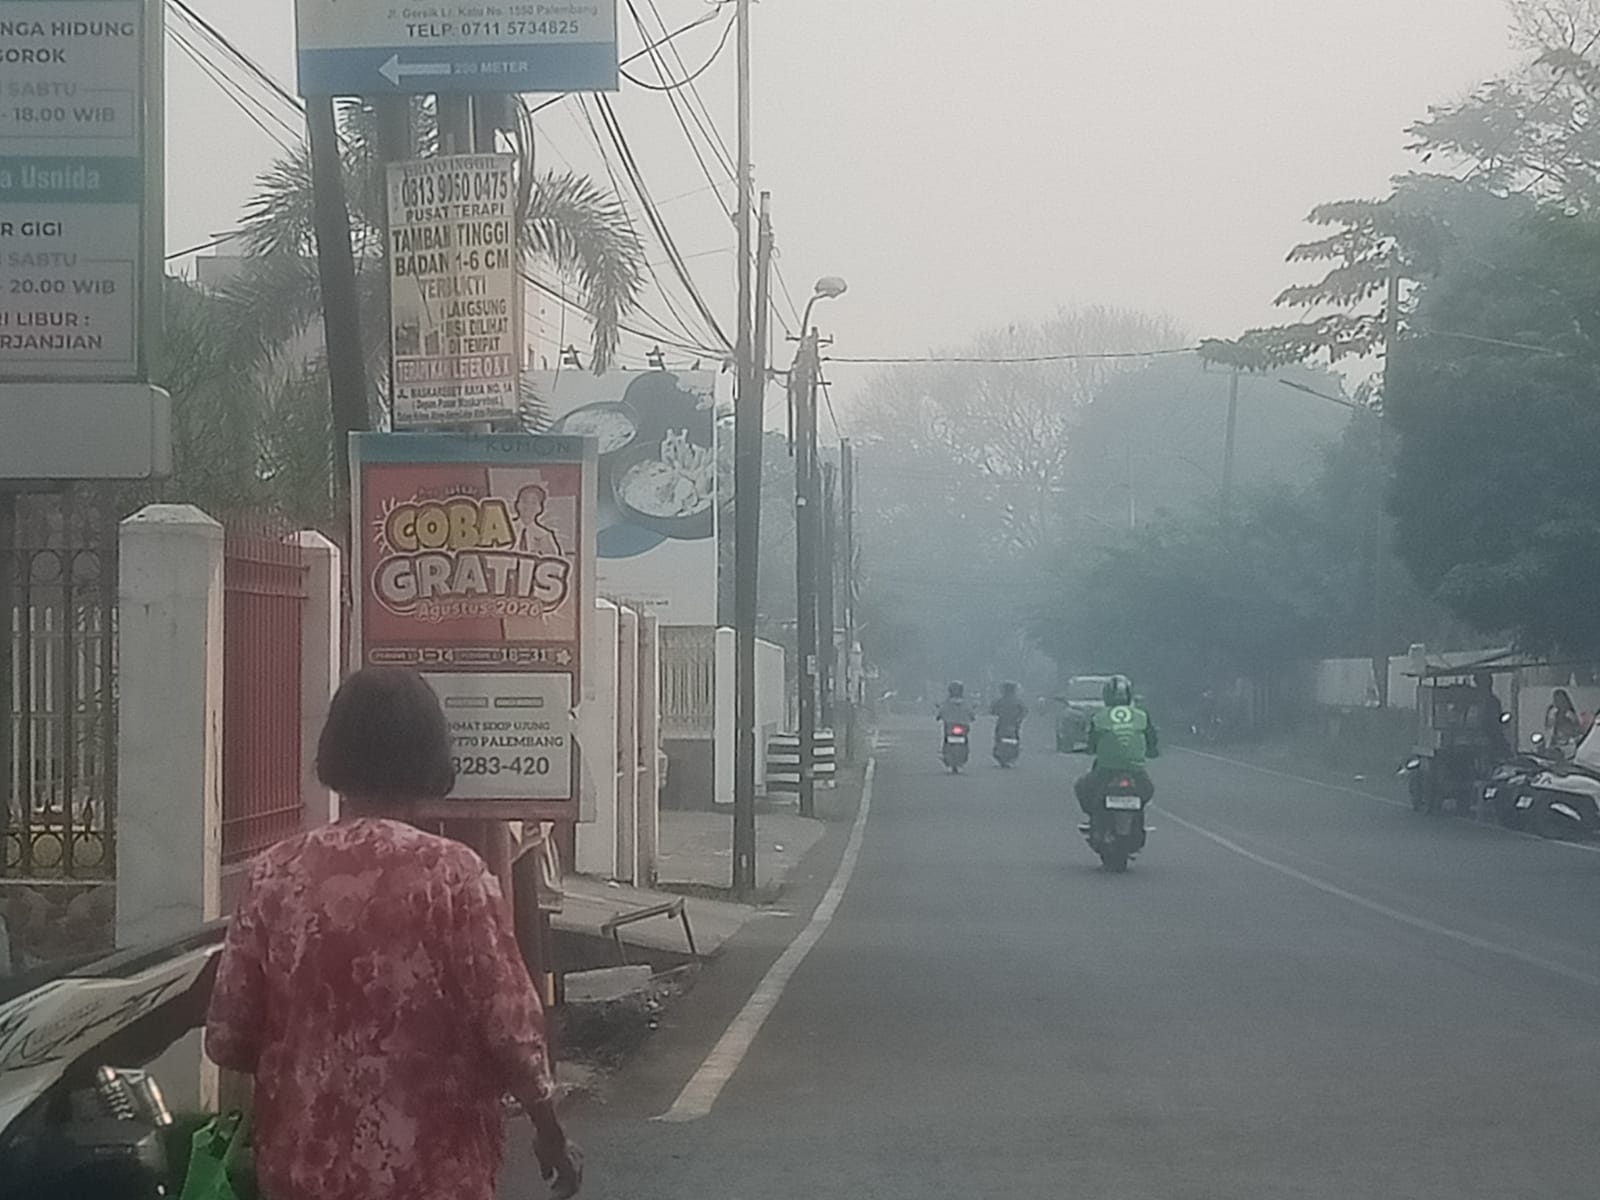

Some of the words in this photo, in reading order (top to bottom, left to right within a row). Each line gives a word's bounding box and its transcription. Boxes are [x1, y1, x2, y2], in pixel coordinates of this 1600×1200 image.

[51, 21, 135, 37] HIDUNG
[462, 21, 500, 36] 0711
[481, 61, 529, 73] METER
[8, 82, 76, 97] SABTU
[15, 107, 66, 122] 18.00
[73, 107, 116, 122] WIB
[22, 165, 99, 189] Usnida
[402, 175, 434, 207] 0813
[406, 205, 449, 222] PUSAT
[453, 203, 504, 218] TERAPI
[21, 221, 62, 237] GIGI
[457, 221, 509, 246] TINGGI
[8, 252, 77, 267] SABTU
[395, 252, 449, 277] BADAN
[485, 248, 509, 269] CM
[9, 279, 65, 294] 20.00
[73, 280, 116, 295] WIB
[17, 311, 78, 327] LIBUR
[1, 334, 103, 350] RJANJIAN
[391, 499, 514, 550] COBA
[380, 553, 568, 602] GRATIS
[418, 601, 489, 620] Agustus
[481, 736, 564, 747] PALEMBANG
